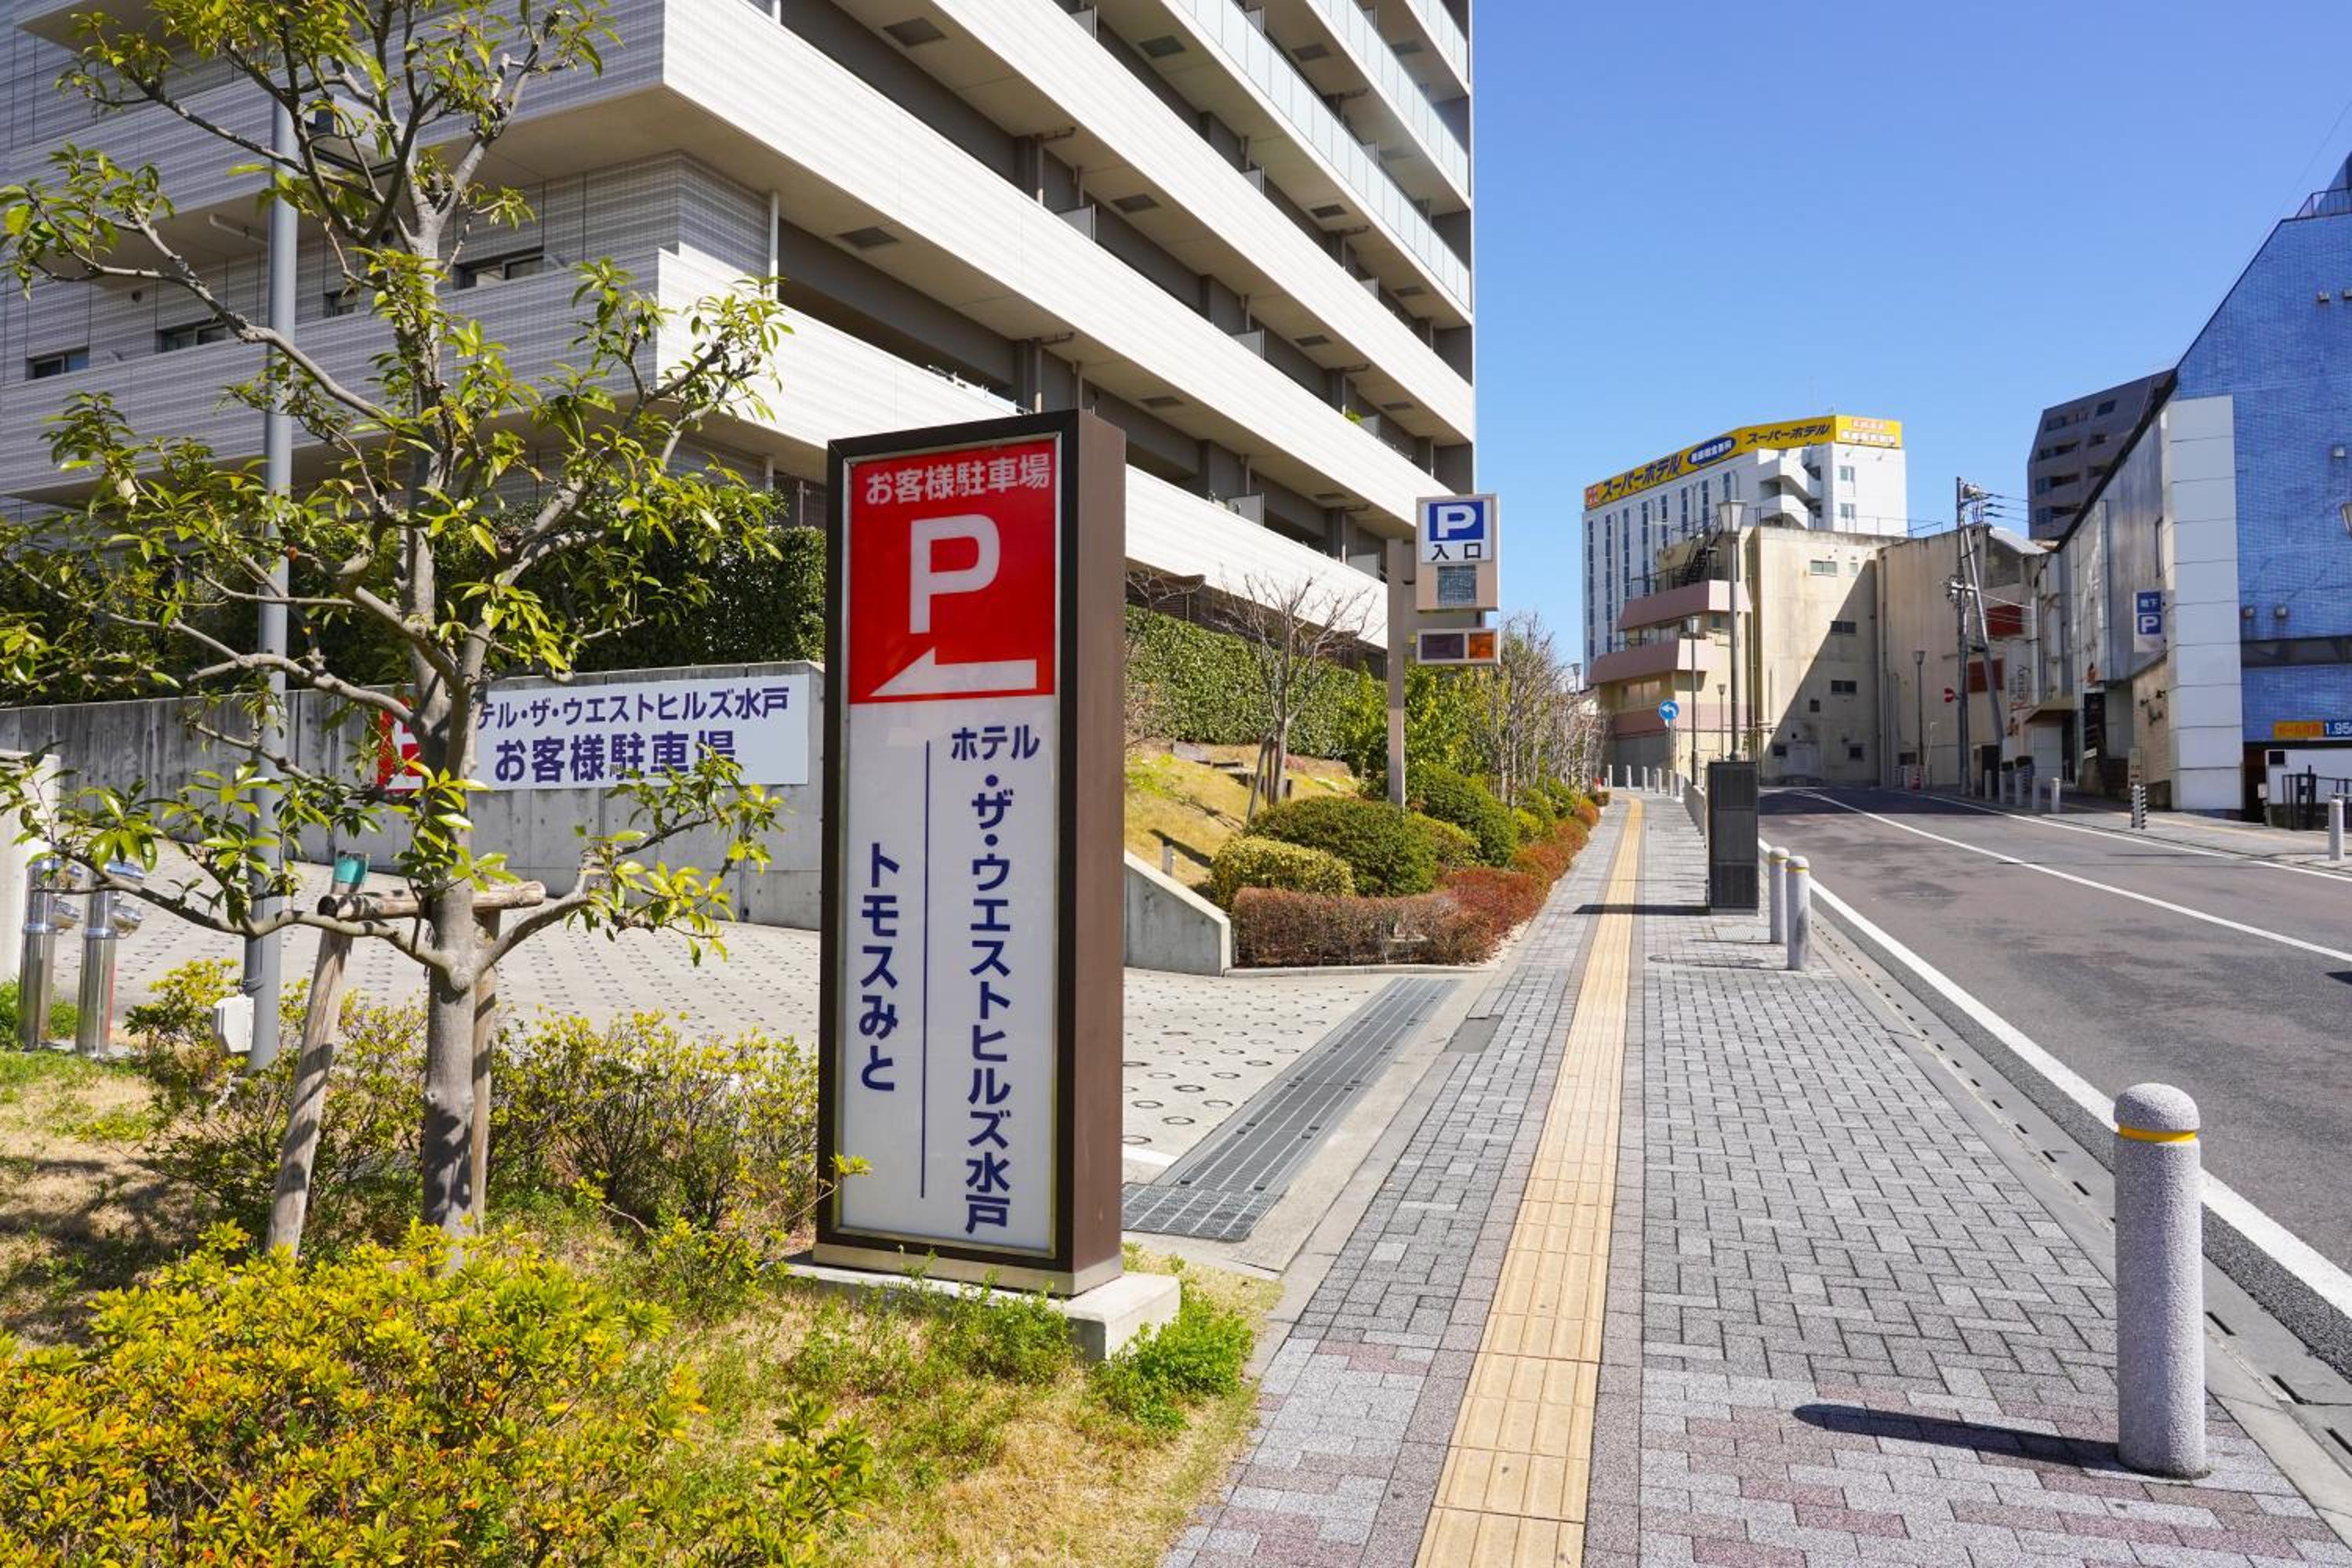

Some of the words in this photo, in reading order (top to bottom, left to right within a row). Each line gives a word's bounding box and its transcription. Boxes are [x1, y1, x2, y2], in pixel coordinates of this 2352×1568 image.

[1746, 424, 1831, 445] スーパーホテル
[866, 453, 1050, 505] お客様駐車場
[1601, 452, 1682, 501] スーパーホテル
[1437, 504, 1476, 539] P
[1432, 543, 1482, 561] 入口
[909, 514, 1000, 633] P
[2141, 615, 2158, 633] P
[477, 686, 789, 730] テル・ザ・ウエストヒルズ水戸
[951, 724, 1040, 761] ホテル
[859, 842, 900, 1091] トモスみと
